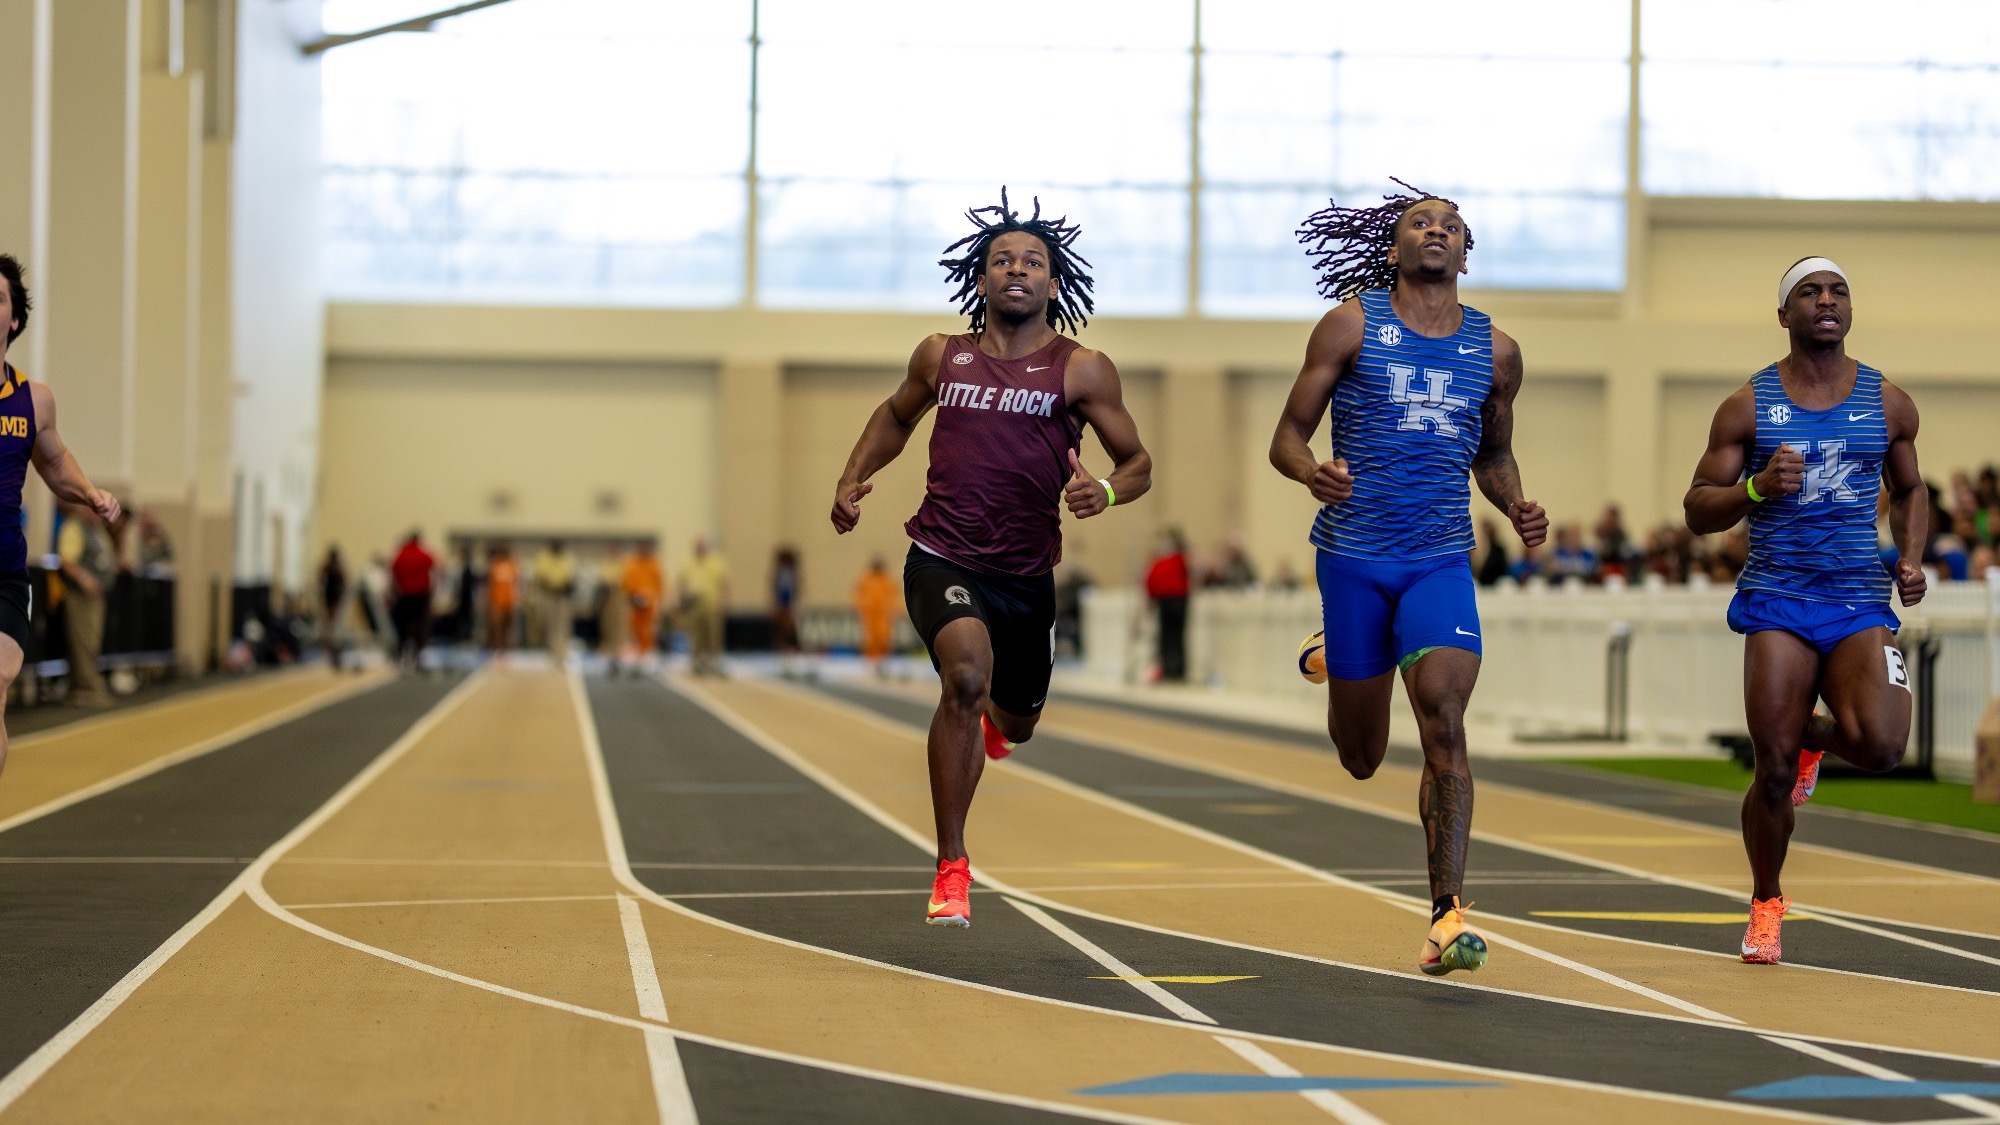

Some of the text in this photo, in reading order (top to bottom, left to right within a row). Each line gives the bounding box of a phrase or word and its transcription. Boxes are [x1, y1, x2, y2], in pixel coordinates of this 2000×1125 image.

[1379, 325, 1401, 345] SEC
[938, 382, 1058, 418] LITTLE ROCK
[1387, 363, 1469, 438] UK
[1768, 404, 1791, 424] SEC
[0, 415, 28, 438] MB
[1891, 650, 1907, 686] 3
